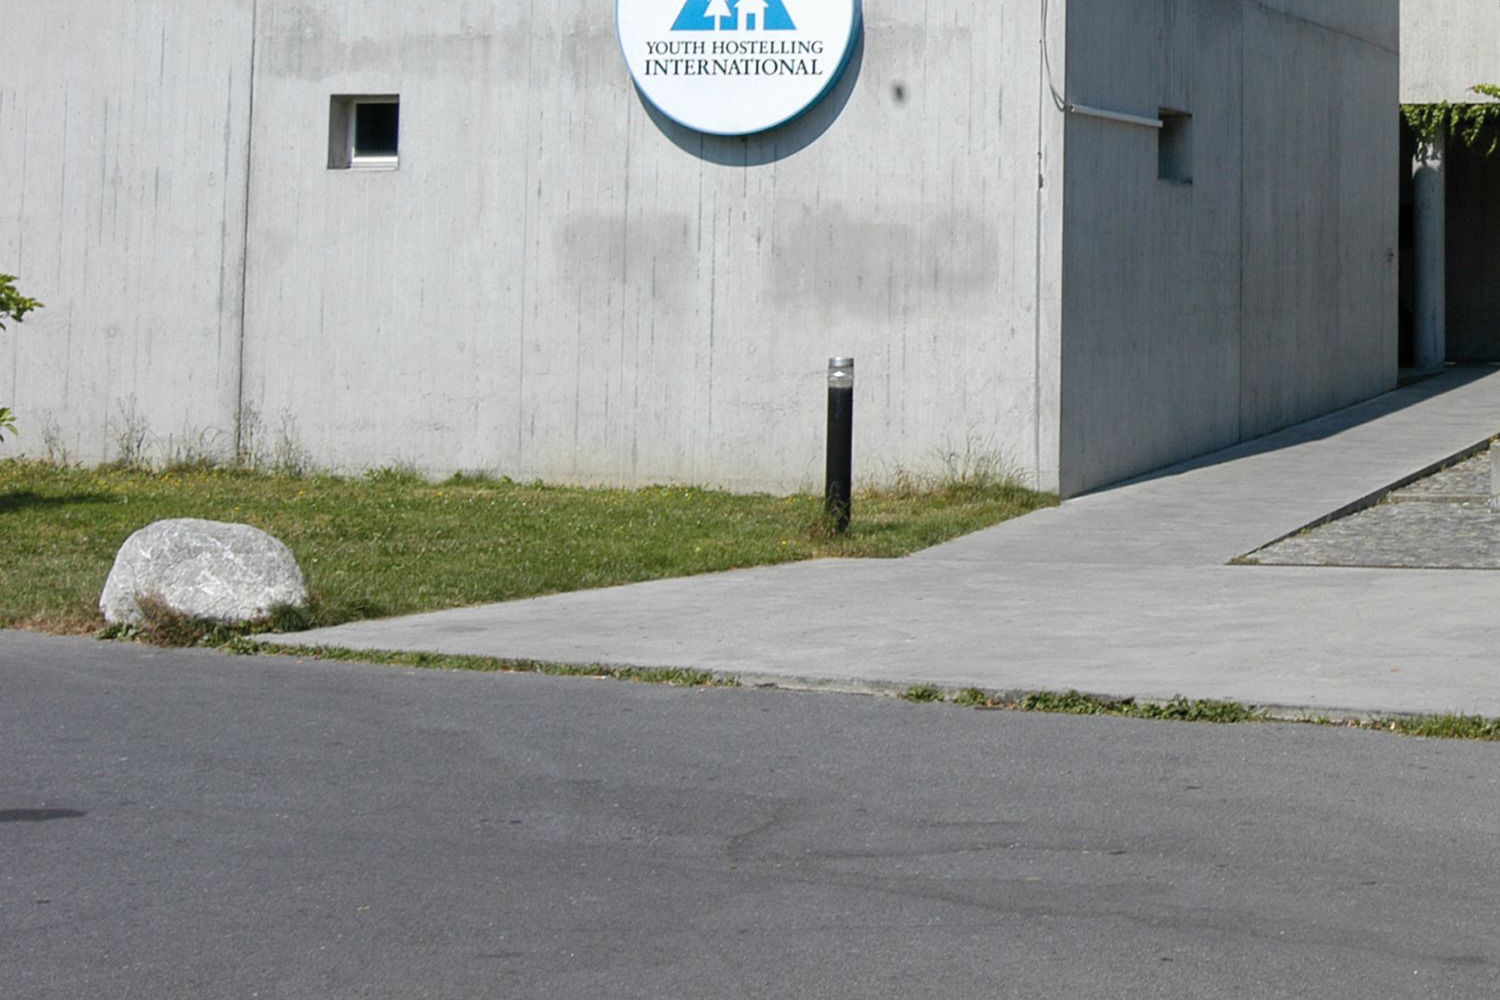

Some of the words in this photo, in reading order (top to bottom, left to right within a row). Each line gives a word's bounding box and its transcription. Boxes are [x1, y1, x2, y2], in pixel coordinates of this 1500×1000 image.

[646, 40, 705, 55] YOUTH
[712, 40, 824, 55] HOSTELLING
[644, 58, 823, 76] INTERNATIONAL
